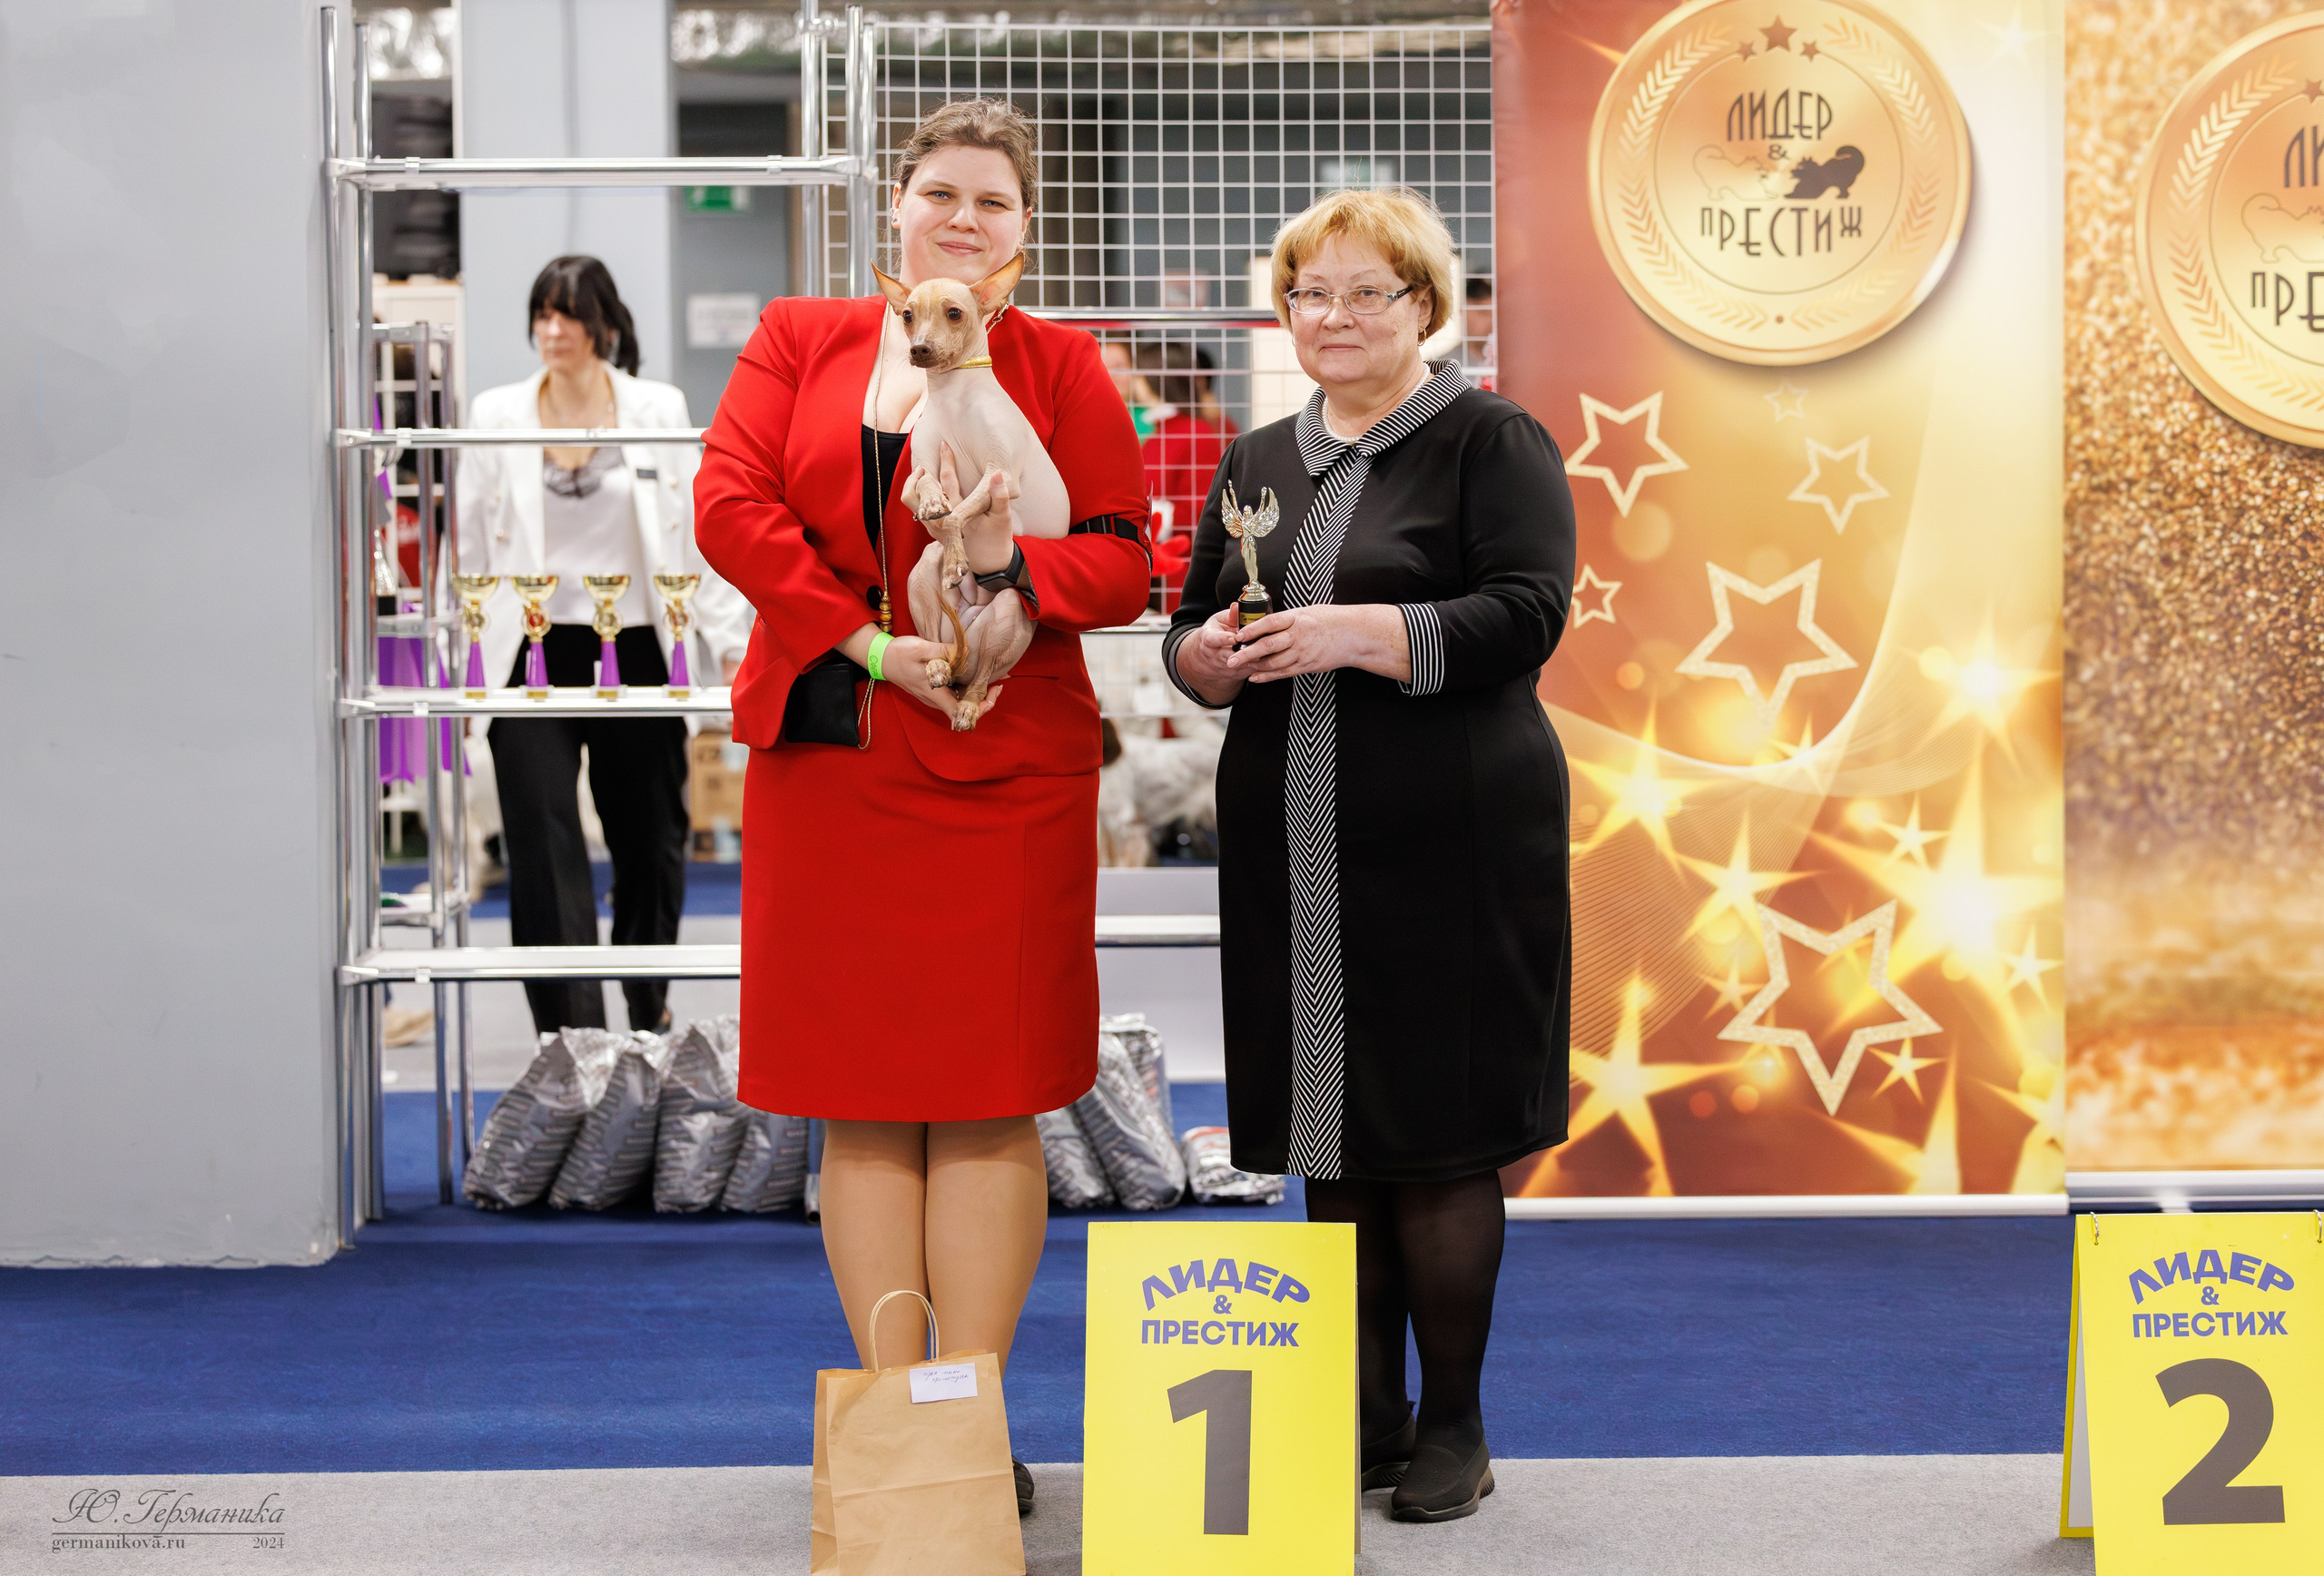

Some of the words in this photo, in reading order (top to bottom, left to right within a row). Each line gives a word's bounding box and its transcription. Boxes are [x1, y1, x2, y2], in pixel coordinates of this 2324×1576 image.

[1727, 88, 1832, 142] ЛИДЕР
[1768, 145, 1791, 161] &
[1700, 206, 1862, 257] ПРЕСТИЖ
[1141, 1258, 1311, 1311] ЛИДЕР
[2129, 1249, 2295, 1305] ЛИДЕР
[2201, 1285, 2220, 1305] &
[1212, 1294, 1233, 1315] &
[2132, 1311, 2289, 1338] ПРЕСТИЖ
[1141, 1319, 1300, 1347] ПРЕСТИЖ
[1167, 1369, 1253, 1535] 1
[2155, 1357, 2286, 1526] 2
